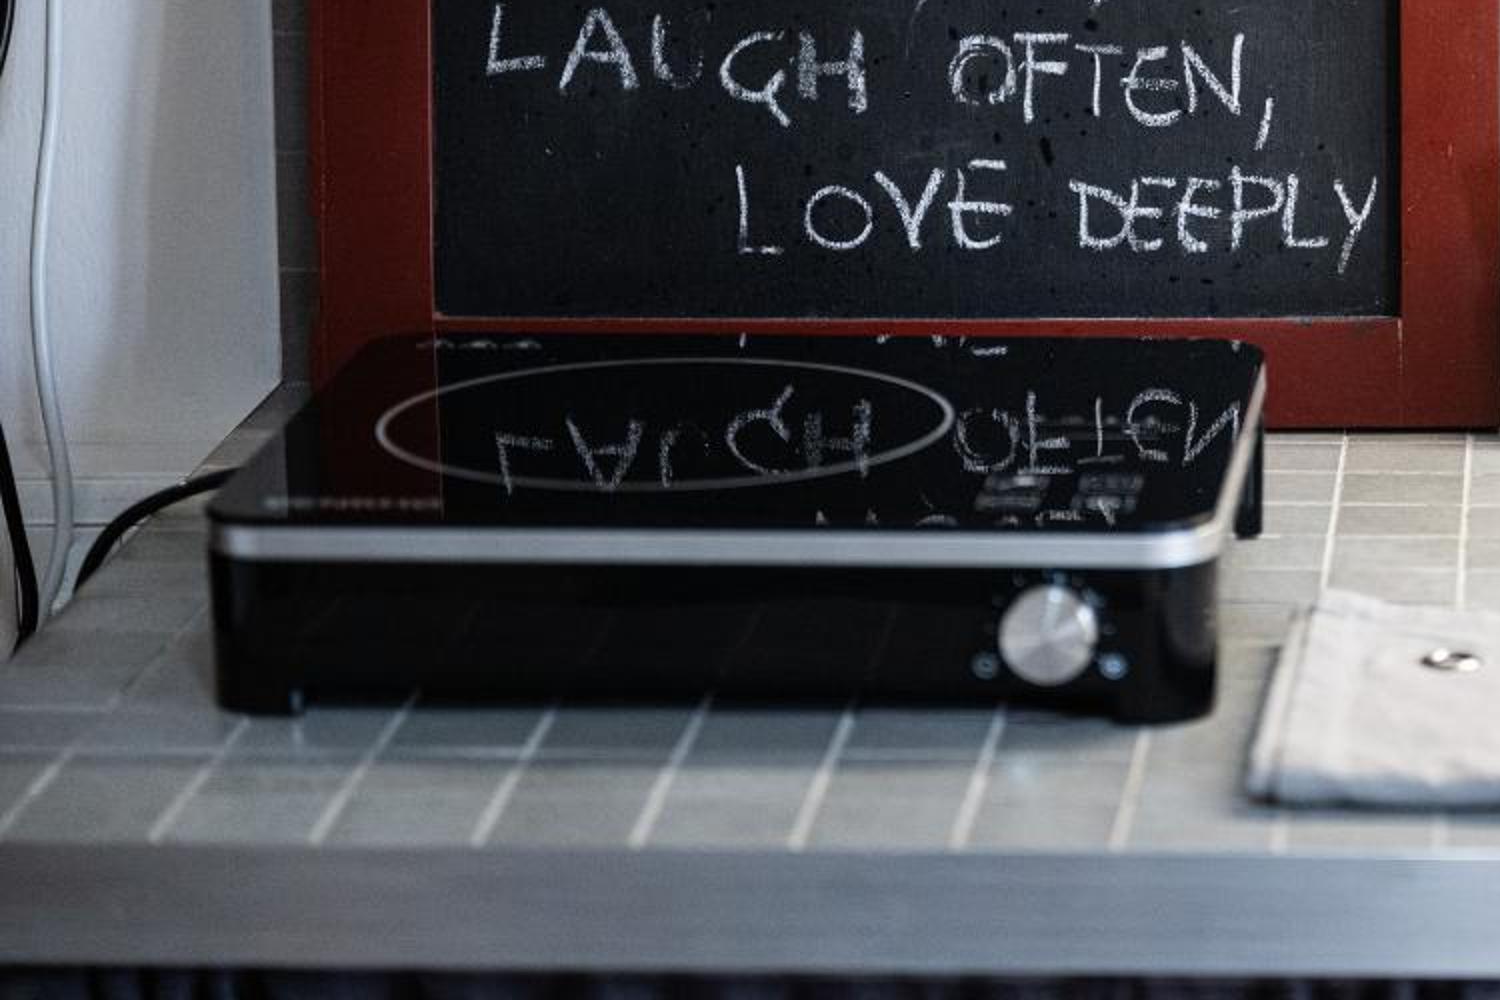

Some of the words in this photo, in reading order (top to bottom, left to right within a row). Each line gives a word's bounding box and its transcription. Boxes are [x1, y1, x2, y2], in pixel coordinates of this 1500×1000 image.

[486, 4, 868, 127] LAUGH
[948, 31, 1275, 151] OFTEN,
[735, 158, 1013, 255] LOVE
[1068, 164, 1378, 274] DEEPLY
